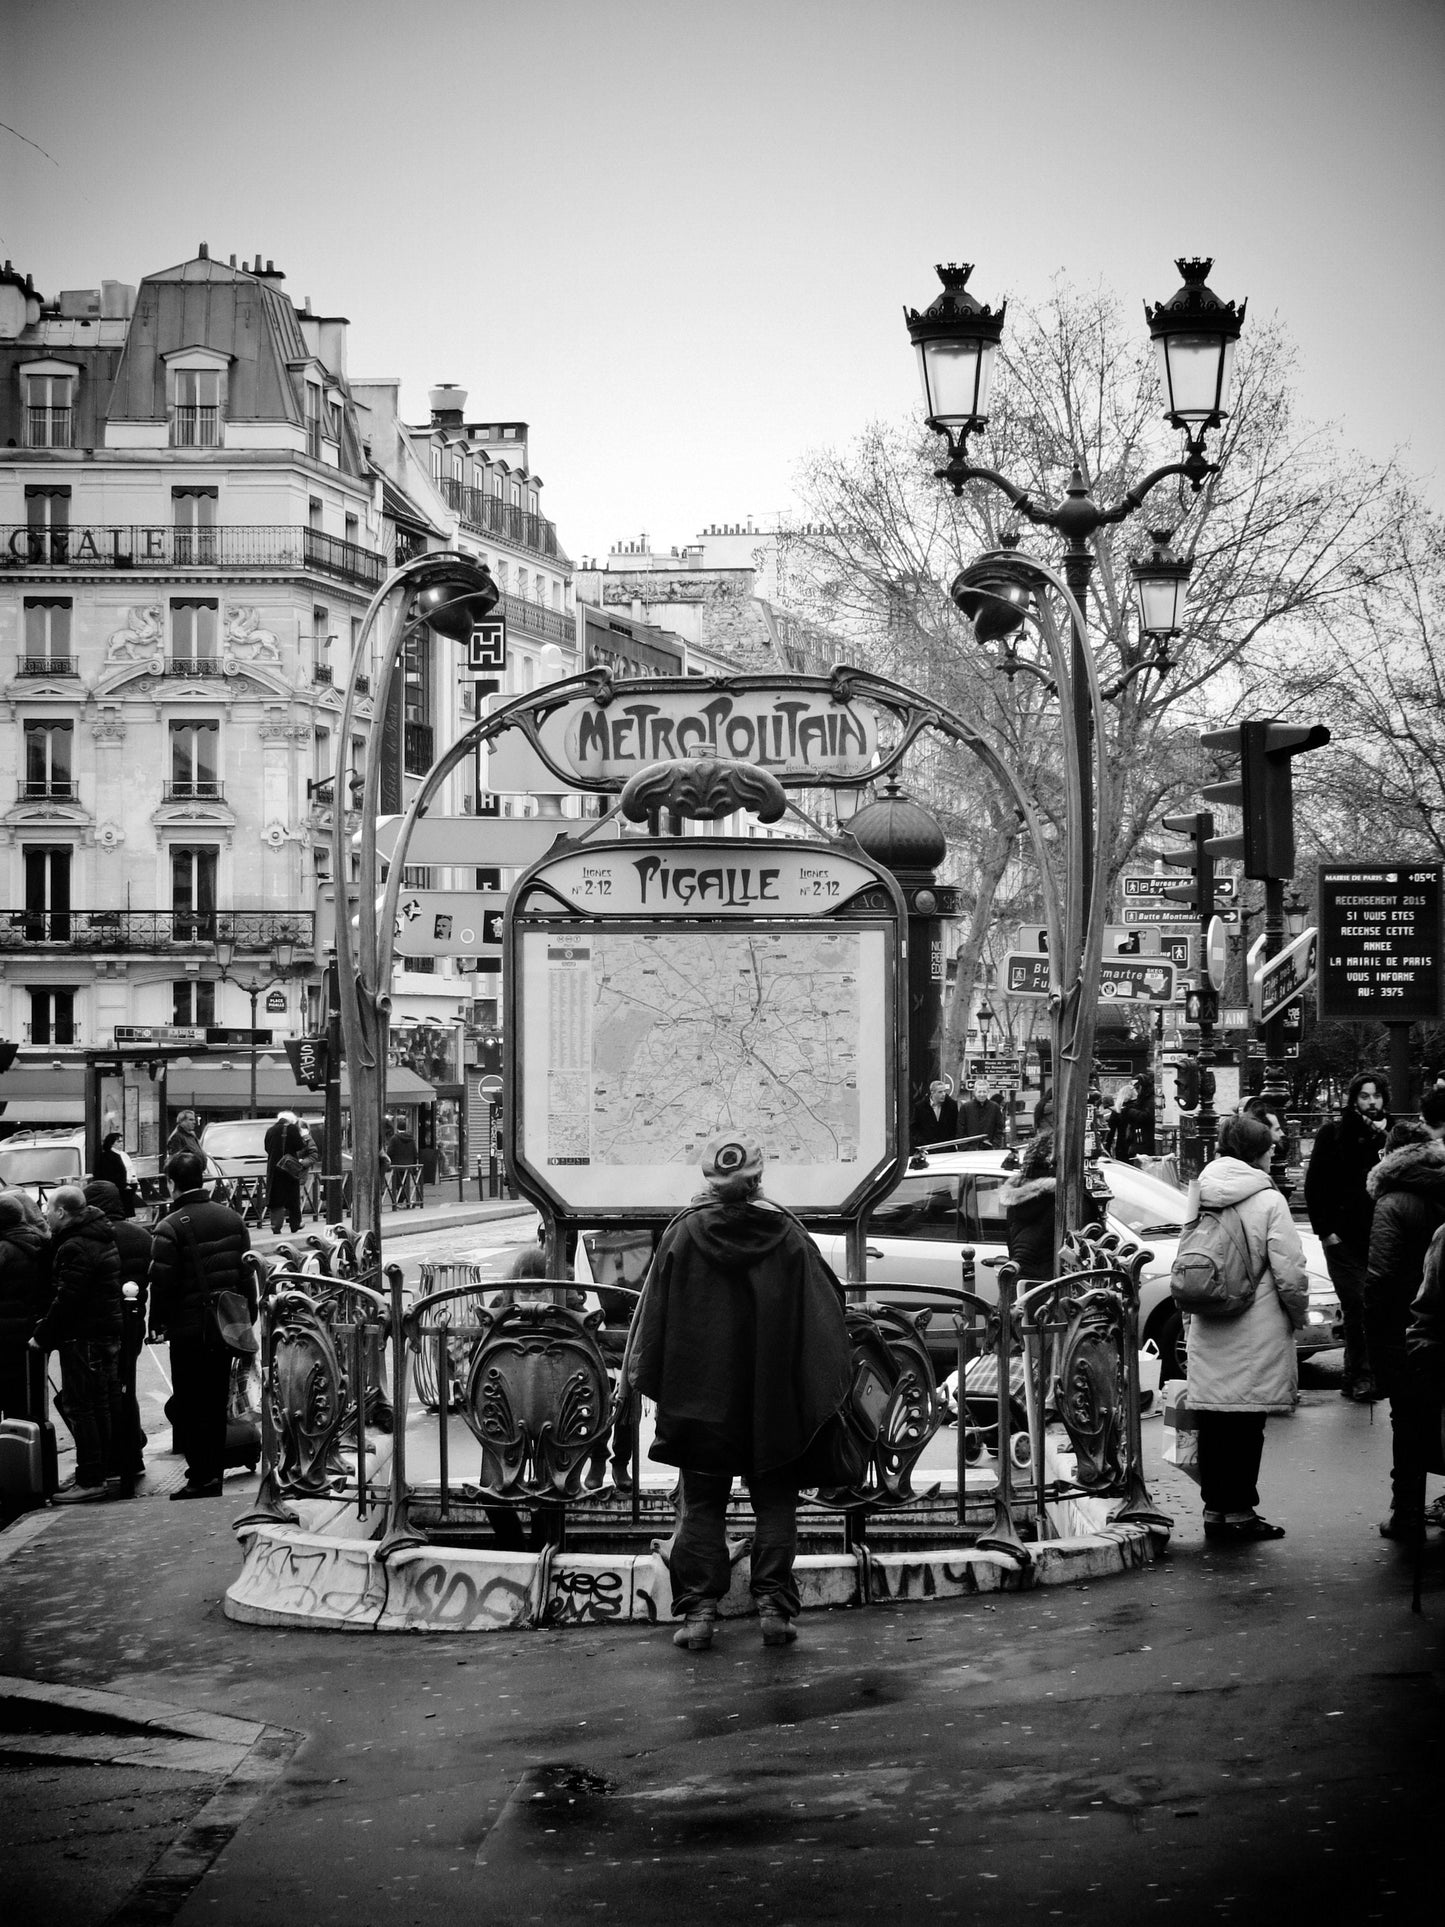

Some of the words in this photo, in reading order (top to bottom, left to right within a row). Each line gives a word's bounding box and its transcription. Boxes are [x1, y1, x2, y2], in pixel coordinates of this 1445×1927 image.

[578, 697, 868, 766] METROPOLITAIN
[631, 855, 781, 907] PIGALLE
[1335, 895, 1397, 905] RECENSEMENT
[1402, 895, 1426, 905] 2015
[1346, 911, 1357, 920] SI
[1363, 911, 1387, 920] VOUS
[1391, 911, 1415, 920] ETES
[1340, 926, 1381, 936] RECENSE
[1385, 926, 1415, 936] CETTE
[1363, 941, 1393, 951] ANNEE
[1329, 957, 1342, 966] LA
[1346, 957, 1381, 966] MAIRIE
[1385, 957, 1398, 966] DE
[1402, 957, 1432, 966] PARIS
[1346, 972, 1370, 981] VOUS
[1375, 972, 1415, 981] INFORME
[1380, 987, 1404, 996] 3975
